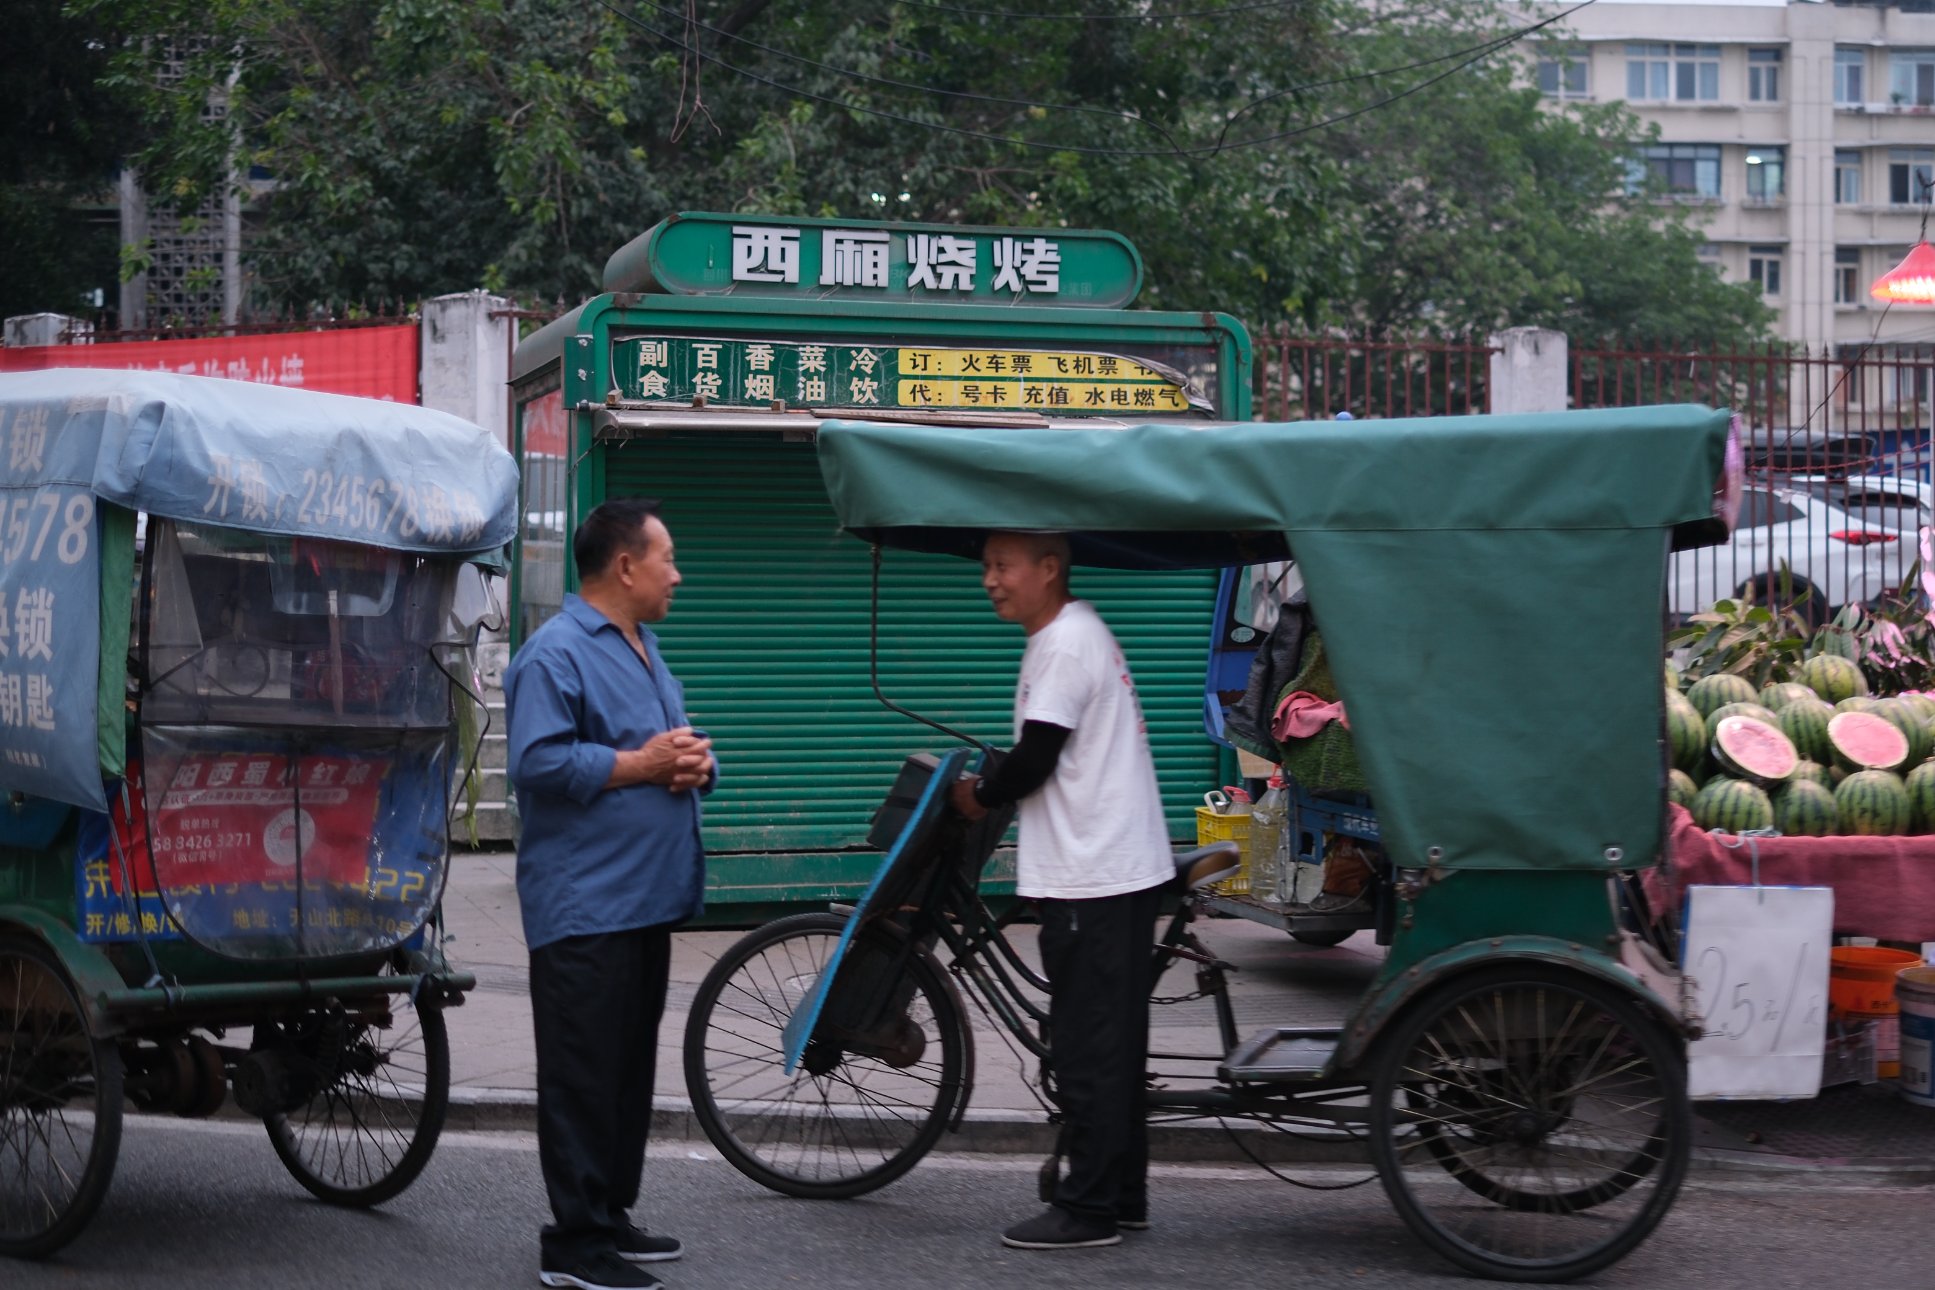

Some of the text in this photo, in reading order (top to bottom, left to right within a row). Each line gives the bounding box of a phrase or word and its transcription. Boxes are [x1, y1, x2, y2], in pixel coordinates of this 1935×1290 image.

[731, 226, 1061, 292] 西厢烧烤
[639, 340, 668, 397] 副食
[692, 343, 723, 399] 百货
[744, 344, 775, 400] 香烟
[798, 345, 827, 402] 菜油
[850, 348, 879, 404] 冷饮
[961, 354, 1032, 373] 火车票
[1047, 356, 1118, 375] 飞机票
[961, 385, 1007, 403] 号卡
[1024, 386, 1070, 404] 充值
[1085, 387, 1180, 407] 水电燃气
[0, 403, 50, 473] 锁
[0, 586, 56, 662] 锁
